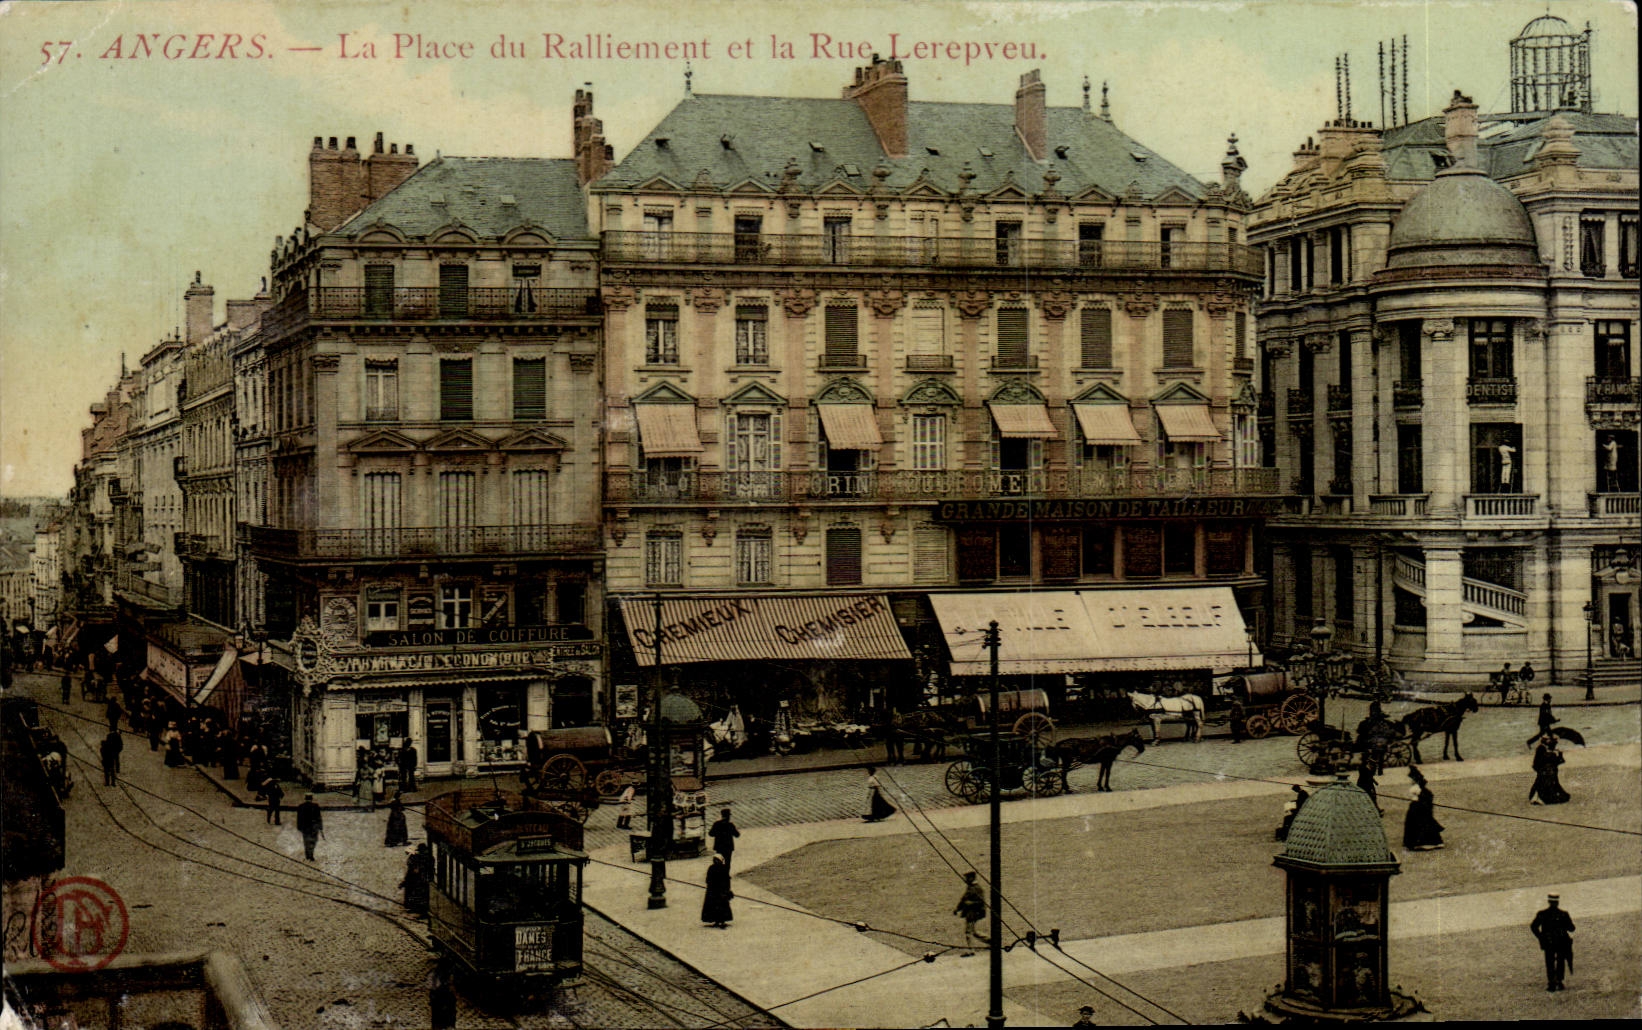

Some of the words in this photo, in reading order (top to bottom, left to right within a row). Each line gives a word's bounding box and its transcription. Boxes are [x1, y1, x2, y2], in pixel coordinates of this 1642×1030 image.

[940, 501, 1028, 520] GRANDE
[1035, 500, 1113, 518] MAISON
[1115, 499, 1144, 517] DE
[775, 598, 886, 644] CHEMISIER
[388, 631, 445, 647] SALON
[488, 626, 571, 643] COIFFURE
